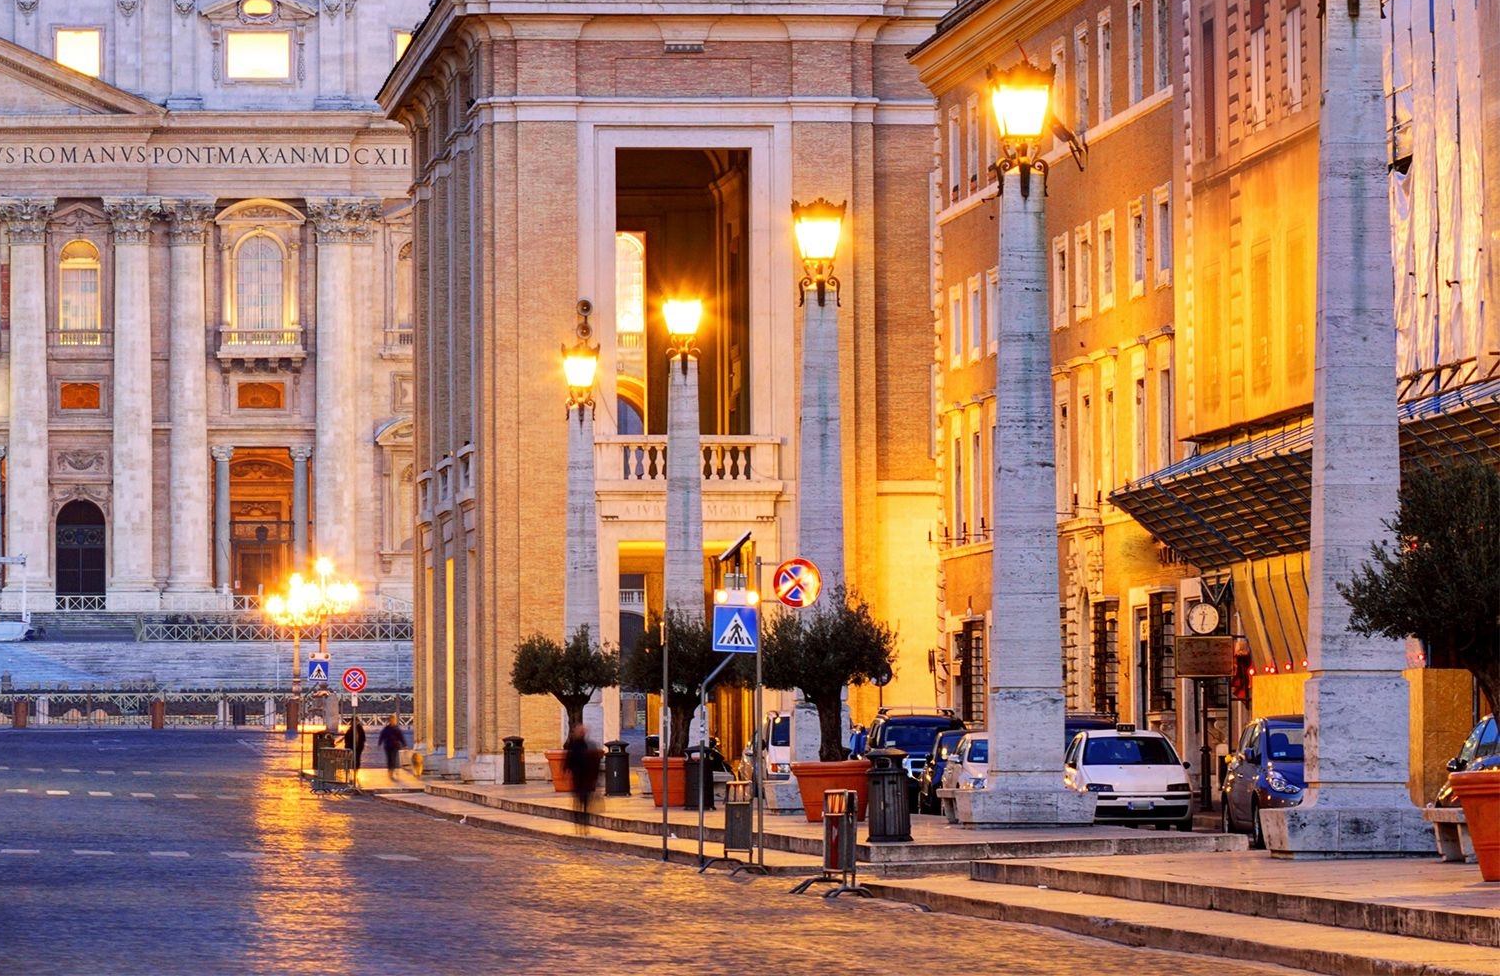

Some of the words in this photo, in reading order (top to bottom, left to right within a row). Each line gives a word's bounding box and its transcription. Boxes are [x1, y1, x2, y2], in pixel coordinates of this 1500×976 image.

[23, 146, 147, 165] ROMANVS
[153, 146, 216, 165] PONT
[218, 146, 270, 165] MAX
[272, 146, 306, 165] AN
[312, 146, 408, 166] MDCXII
